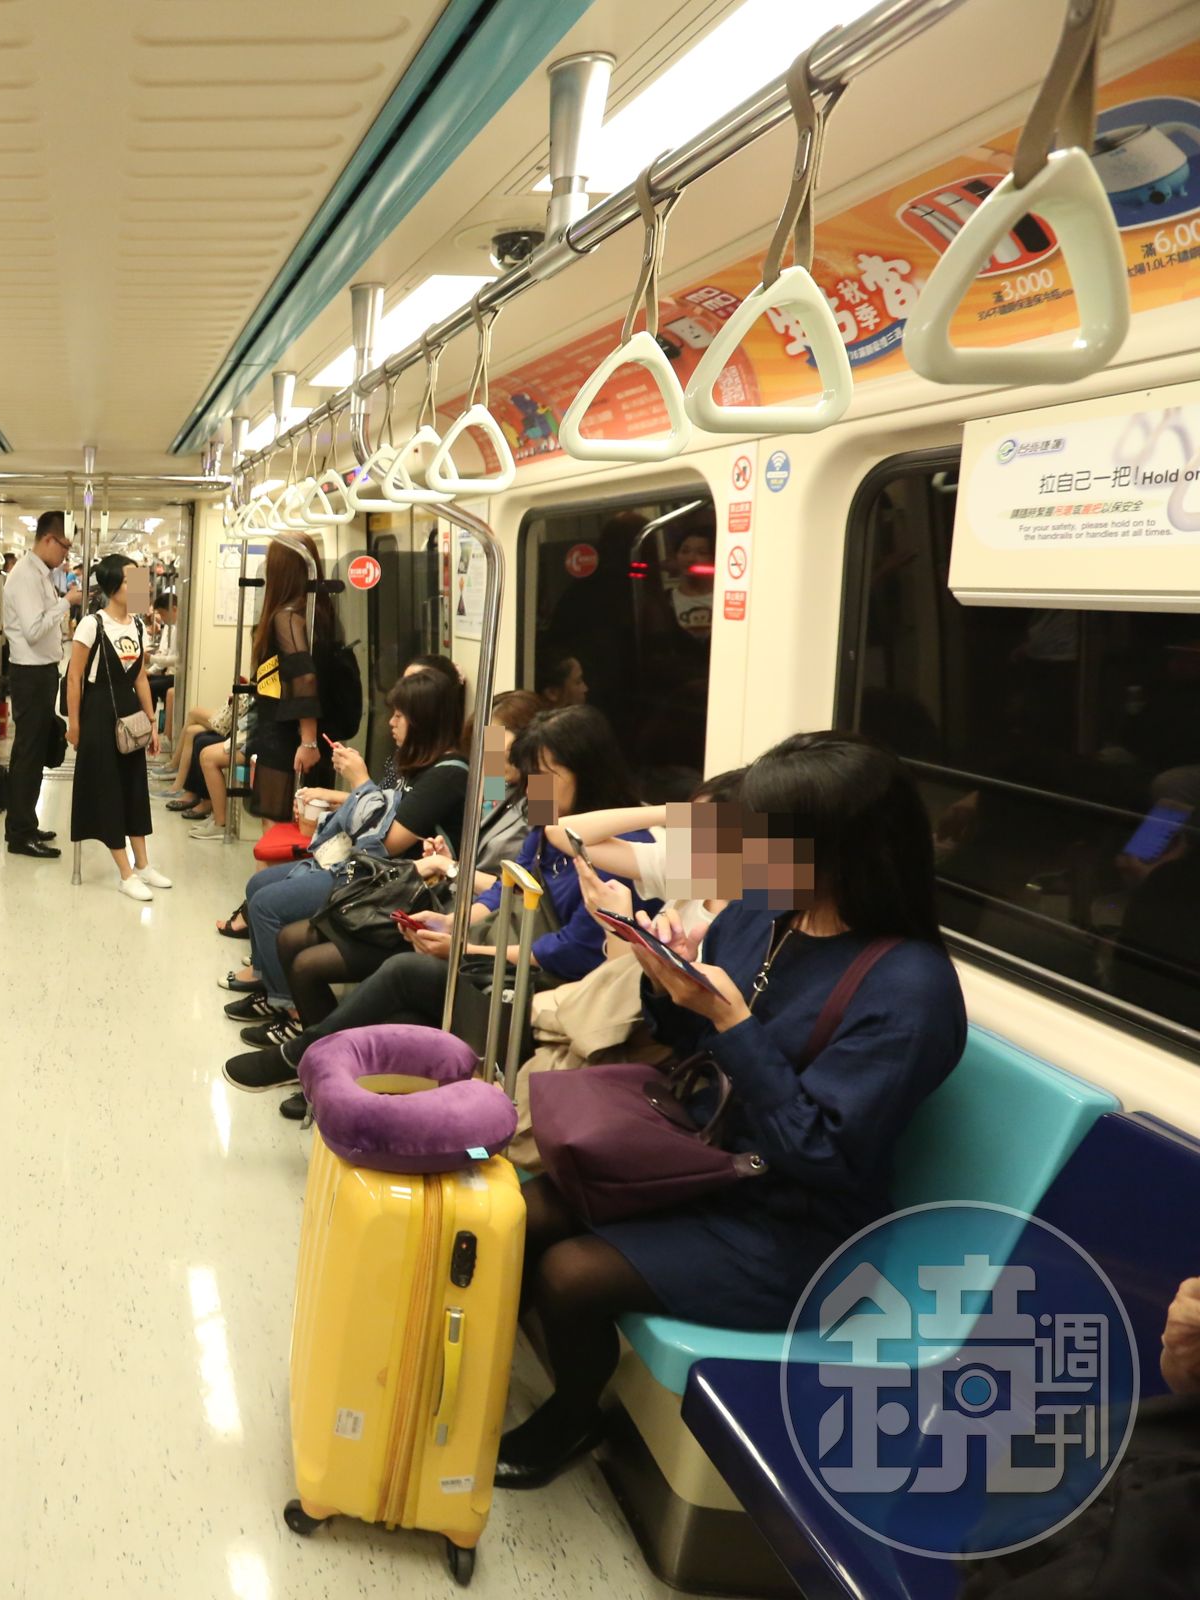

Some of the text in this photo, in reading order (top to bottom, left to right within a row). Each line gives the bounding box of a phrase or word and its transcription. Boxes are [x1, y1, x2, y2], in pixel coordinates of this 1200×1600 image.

[1141, 469, 1179, 485] Hold
[1019, 524, 1031, 532] For
[1032, 524, 1050, 533] your
[1081, 521, 1108, 531] please
[1111, 520, 1130, 528] hold
[1146, 519, 1156, 527] to
[1024, 533, 1036, 541] the
[1037, 532, 1073, 541] handrails
[1086, 530, 1119, 539] handles
[1132, 529, 1143, 537] all
